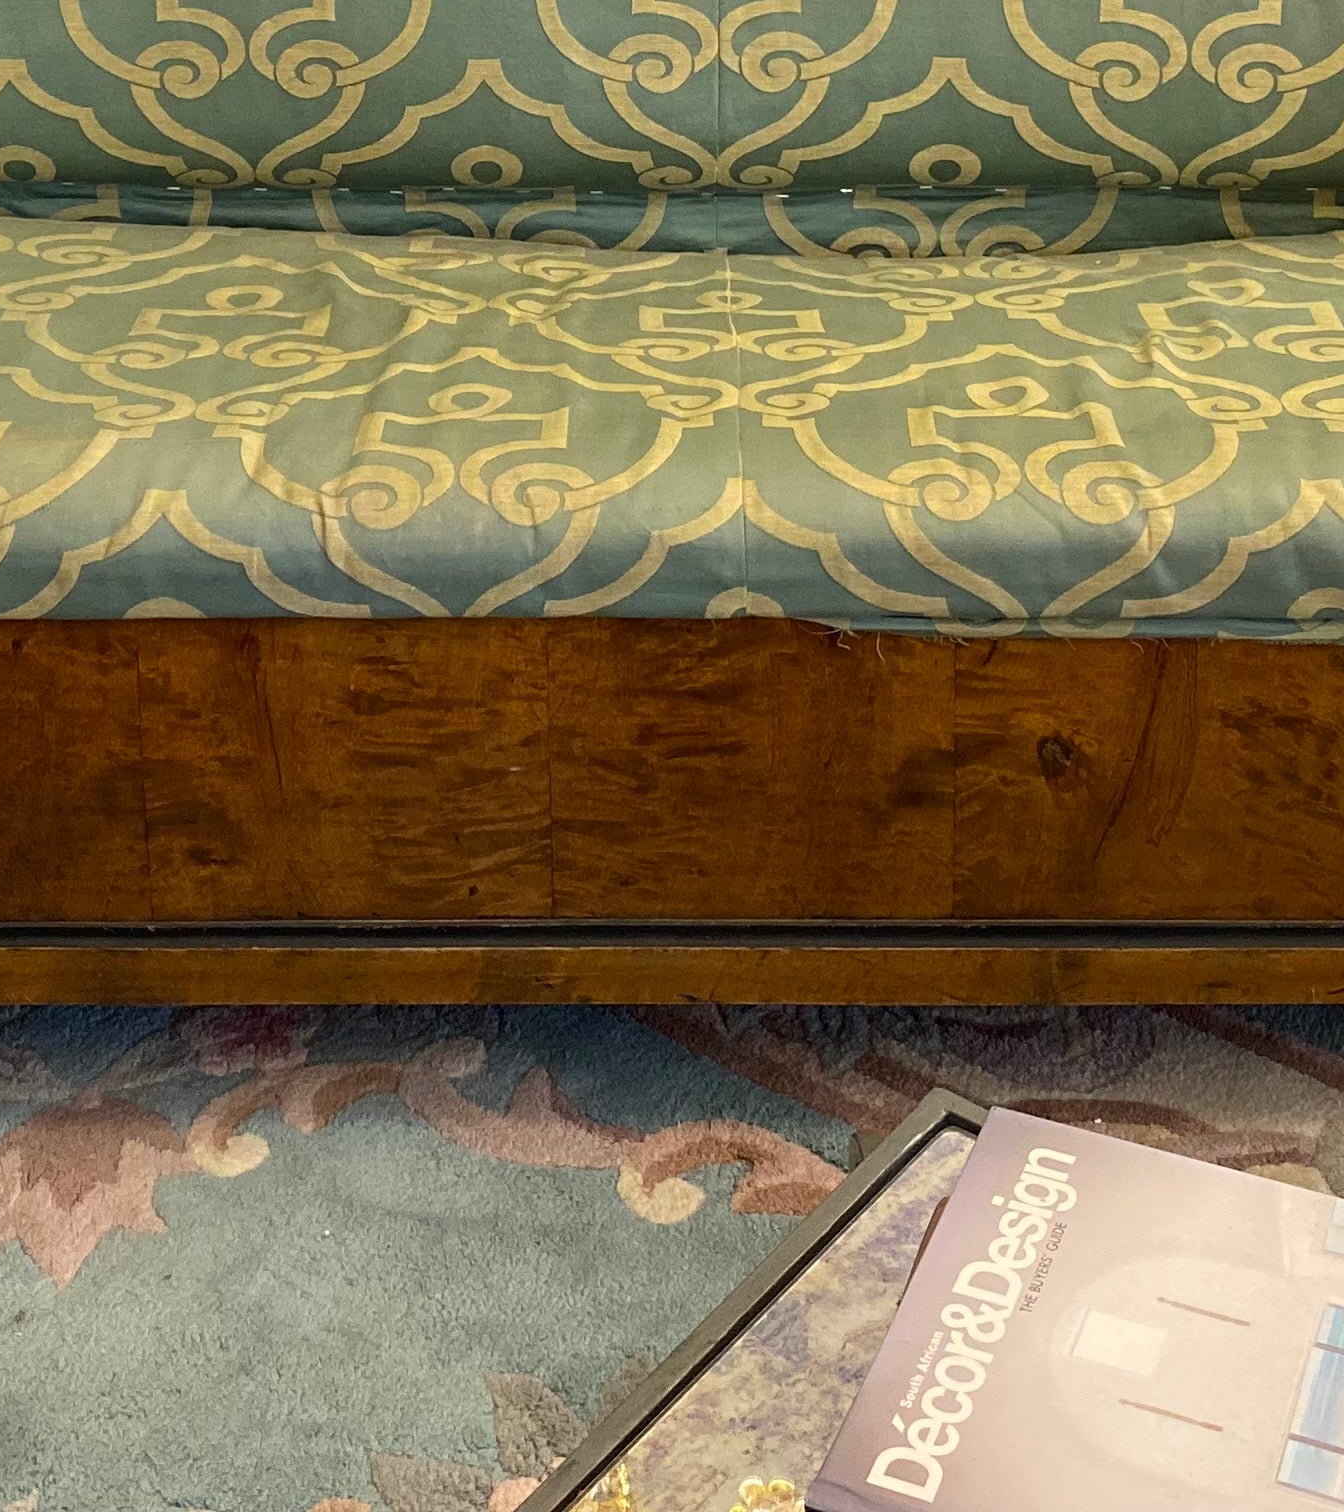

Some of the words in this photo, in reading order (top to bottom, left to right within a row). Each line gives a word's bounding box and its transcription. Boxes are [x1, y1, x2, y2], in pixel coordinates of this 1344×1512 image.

[1019, 1293, 1038, 1313] THE
[1045, 1221, 1068, 1252] GUIDE
[899, 1374, 925, 1409] South
[916, 1330, 945, 1373] African
